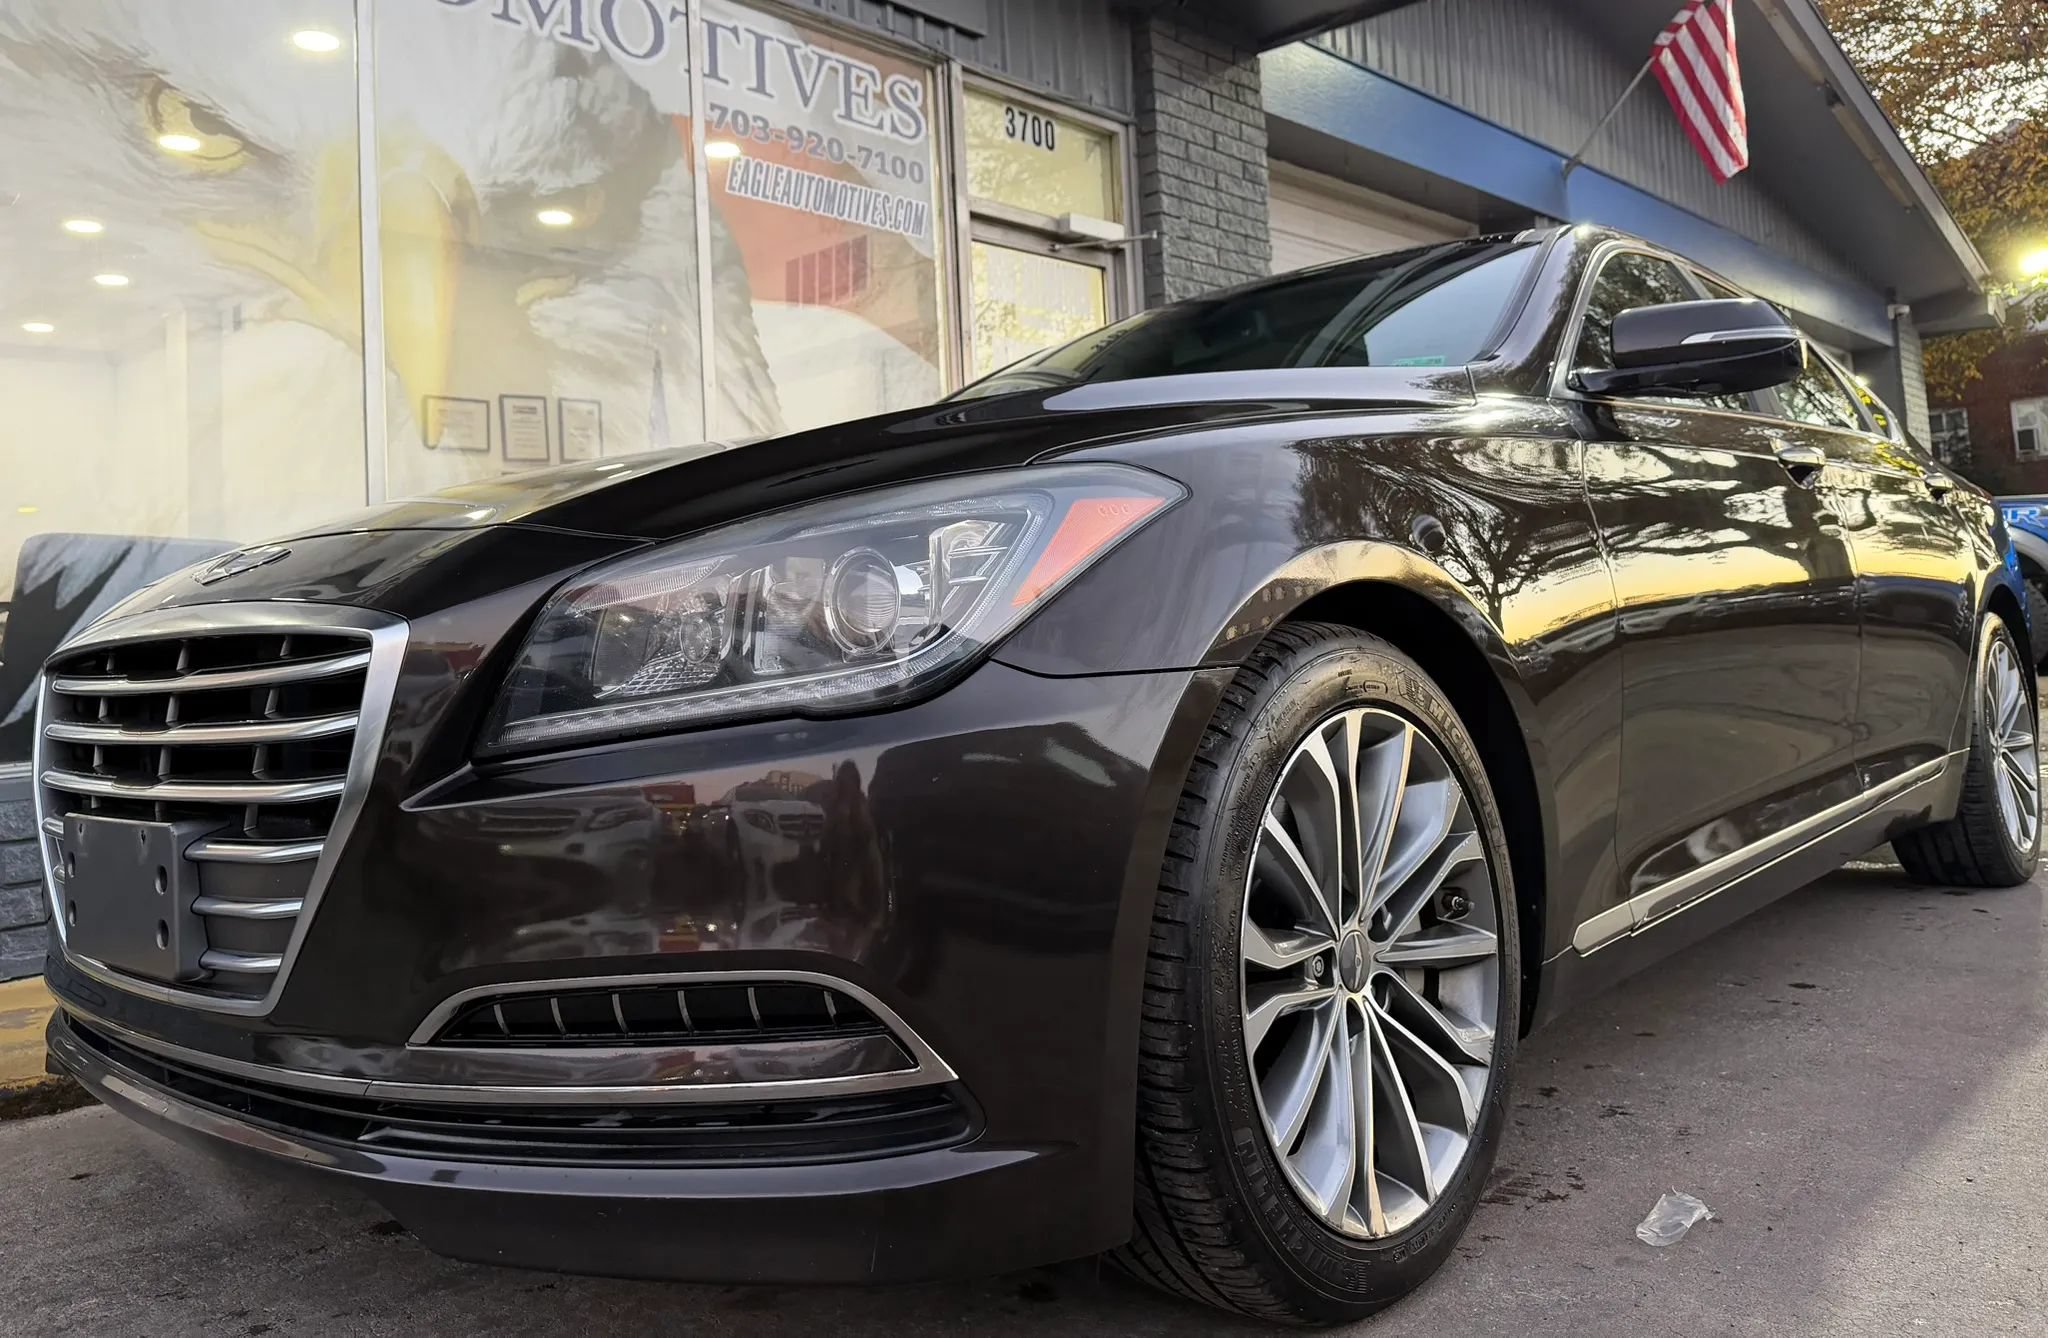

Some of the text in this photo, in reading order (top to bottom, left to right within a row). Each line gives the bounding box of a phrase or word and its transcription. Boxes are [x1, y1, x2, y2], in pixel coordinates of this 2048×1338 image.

[436, 0, 925, 140] MOTIVES
[709, 101, 926, 185] 703-920-7100
[1005, 106, 1055, 151] 3700
[727, 157, 927, 237] EAGLEAUTOMOTIVES.COM
[1428, 697, 1499, 832] MICHELIN
